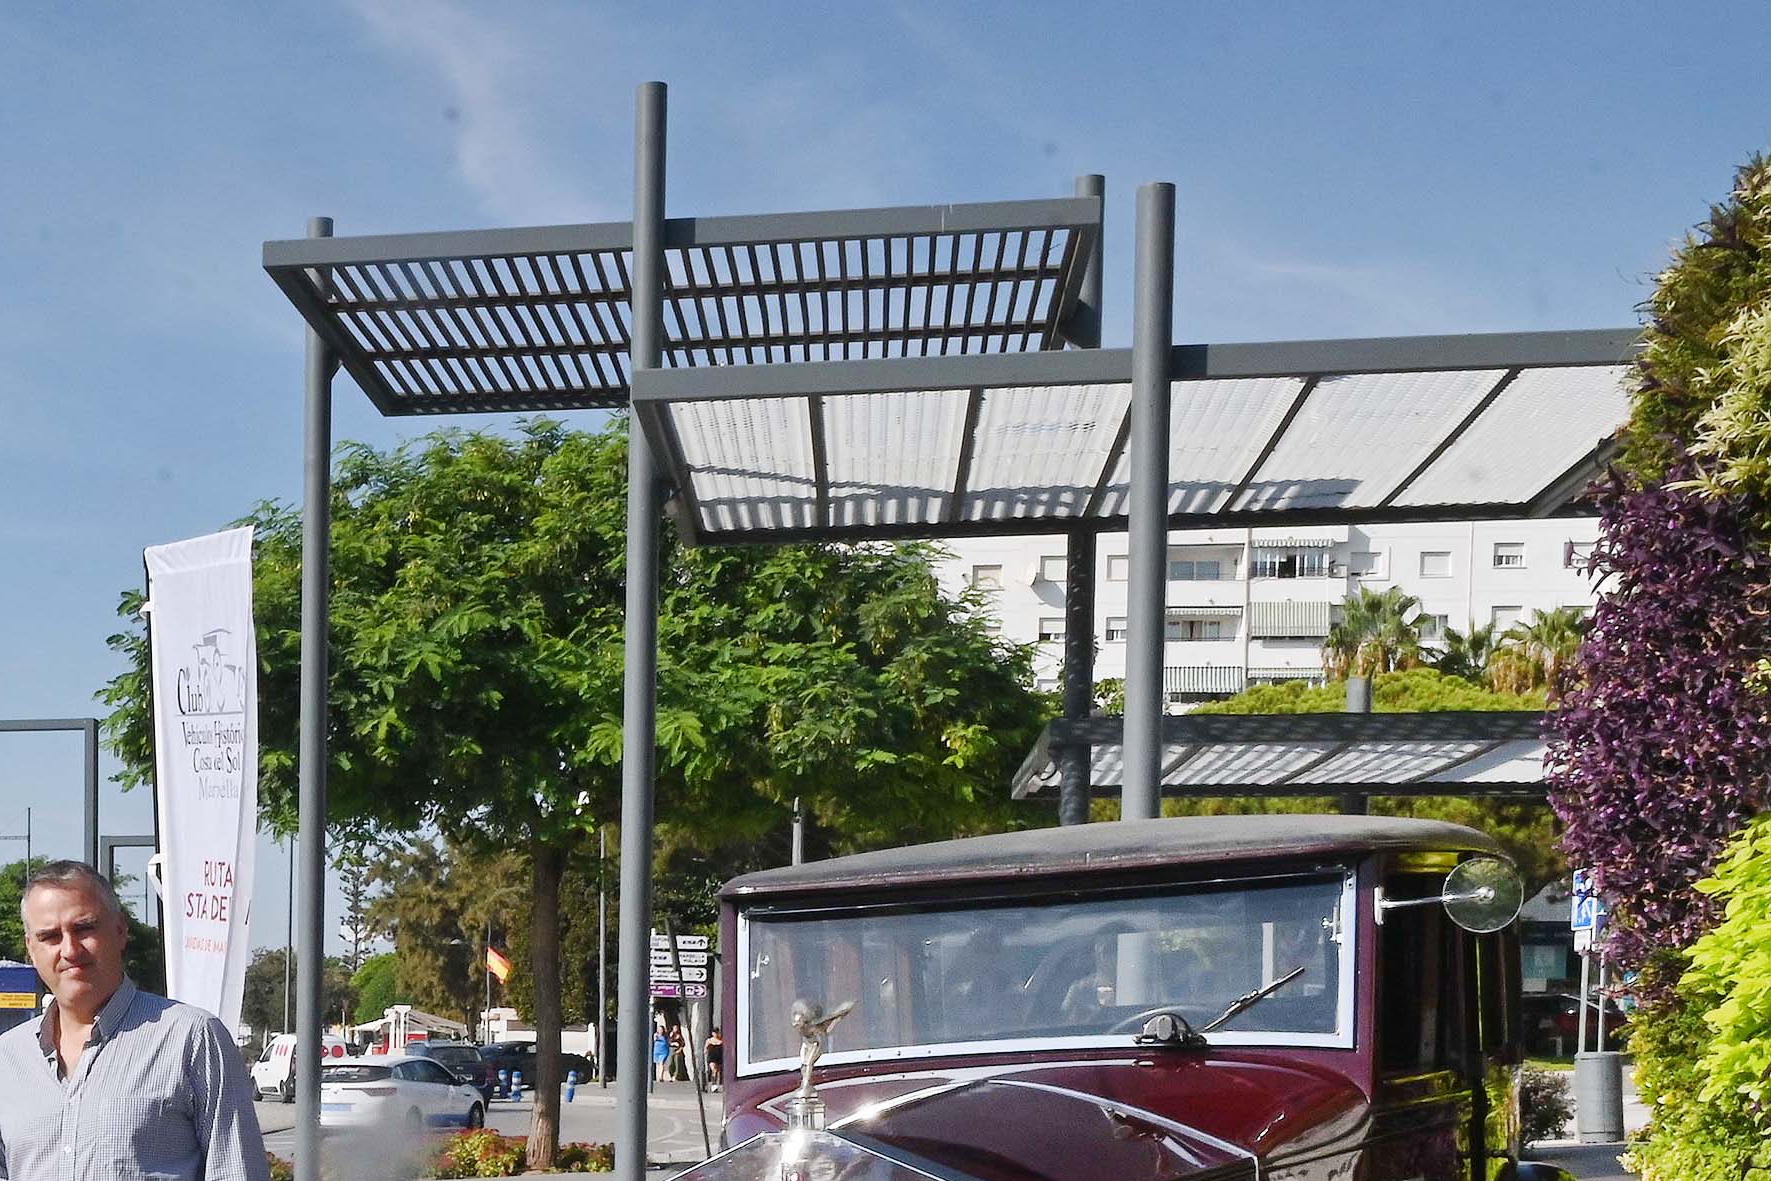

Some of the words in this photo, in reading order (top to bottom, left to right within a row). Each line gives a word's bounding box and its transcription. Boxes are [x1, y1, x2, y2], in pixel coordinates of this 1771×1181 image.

[178, 667, 203, 715] Club
[226, 746, 241, 773] Sol
[204, 861, 233, 889] RUTA
[183, 892, 208, 921] STA
[211, 894, 231, 922] DE
